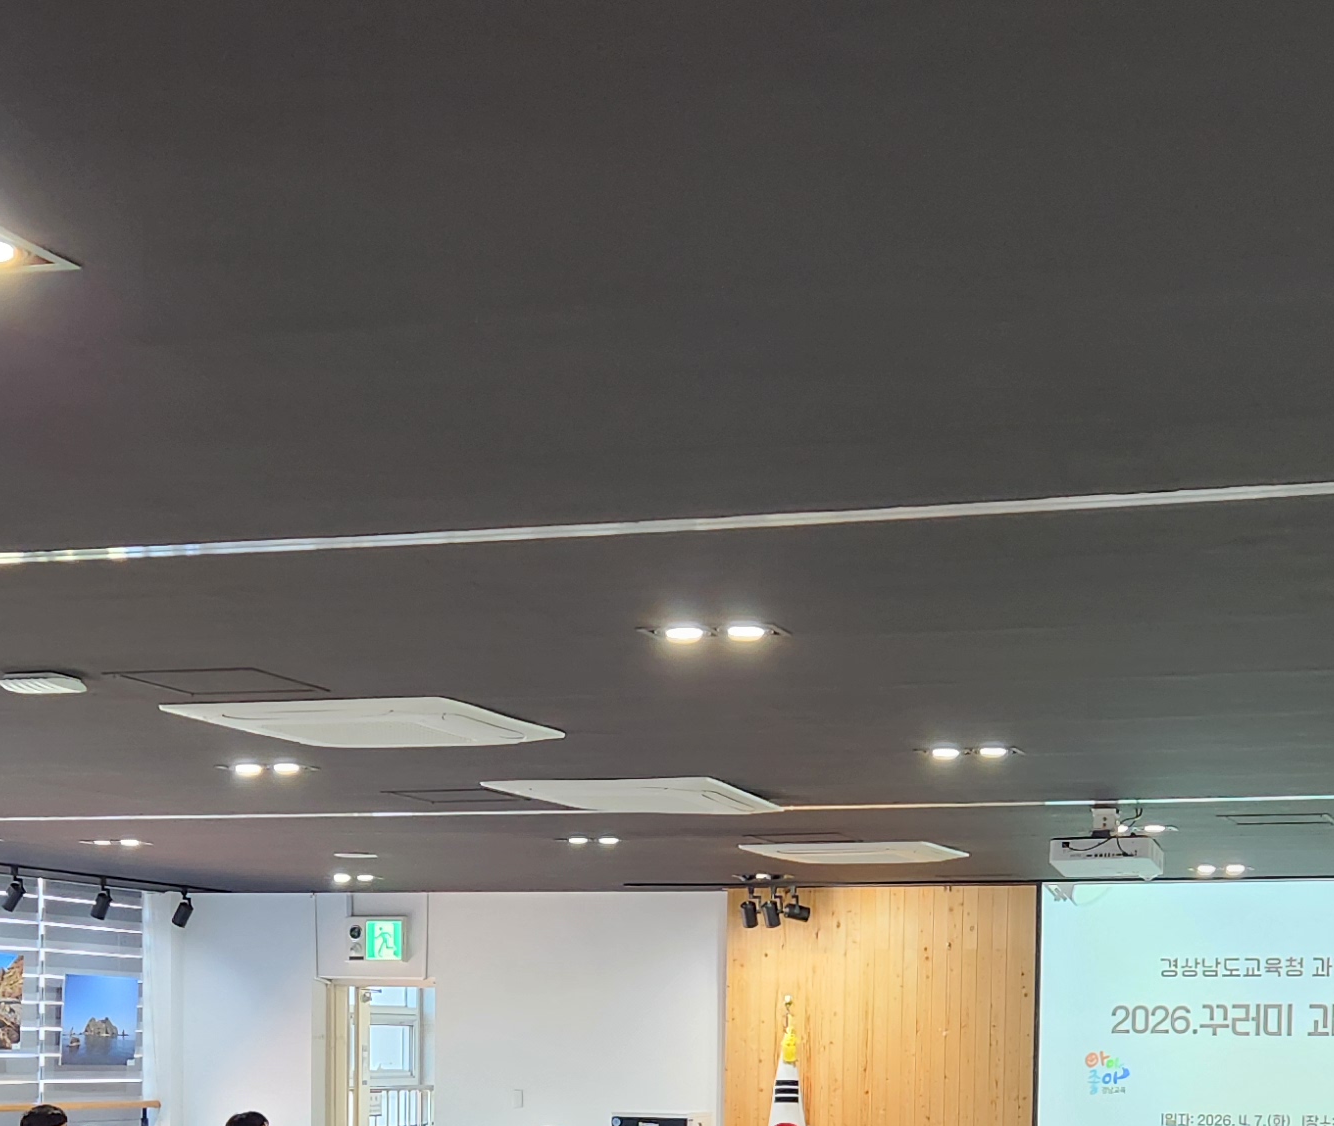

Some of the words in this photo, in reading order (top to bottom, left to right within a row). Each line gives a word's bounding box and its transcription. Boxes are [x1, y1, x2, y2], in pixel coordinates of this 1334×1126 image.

[1160, 957, 1303, 977] 경상남도교육청
[1111, 1003, 1293, 1037] 2026.꾸러미
[1197, 1114, 1235, 1126] 2026.
